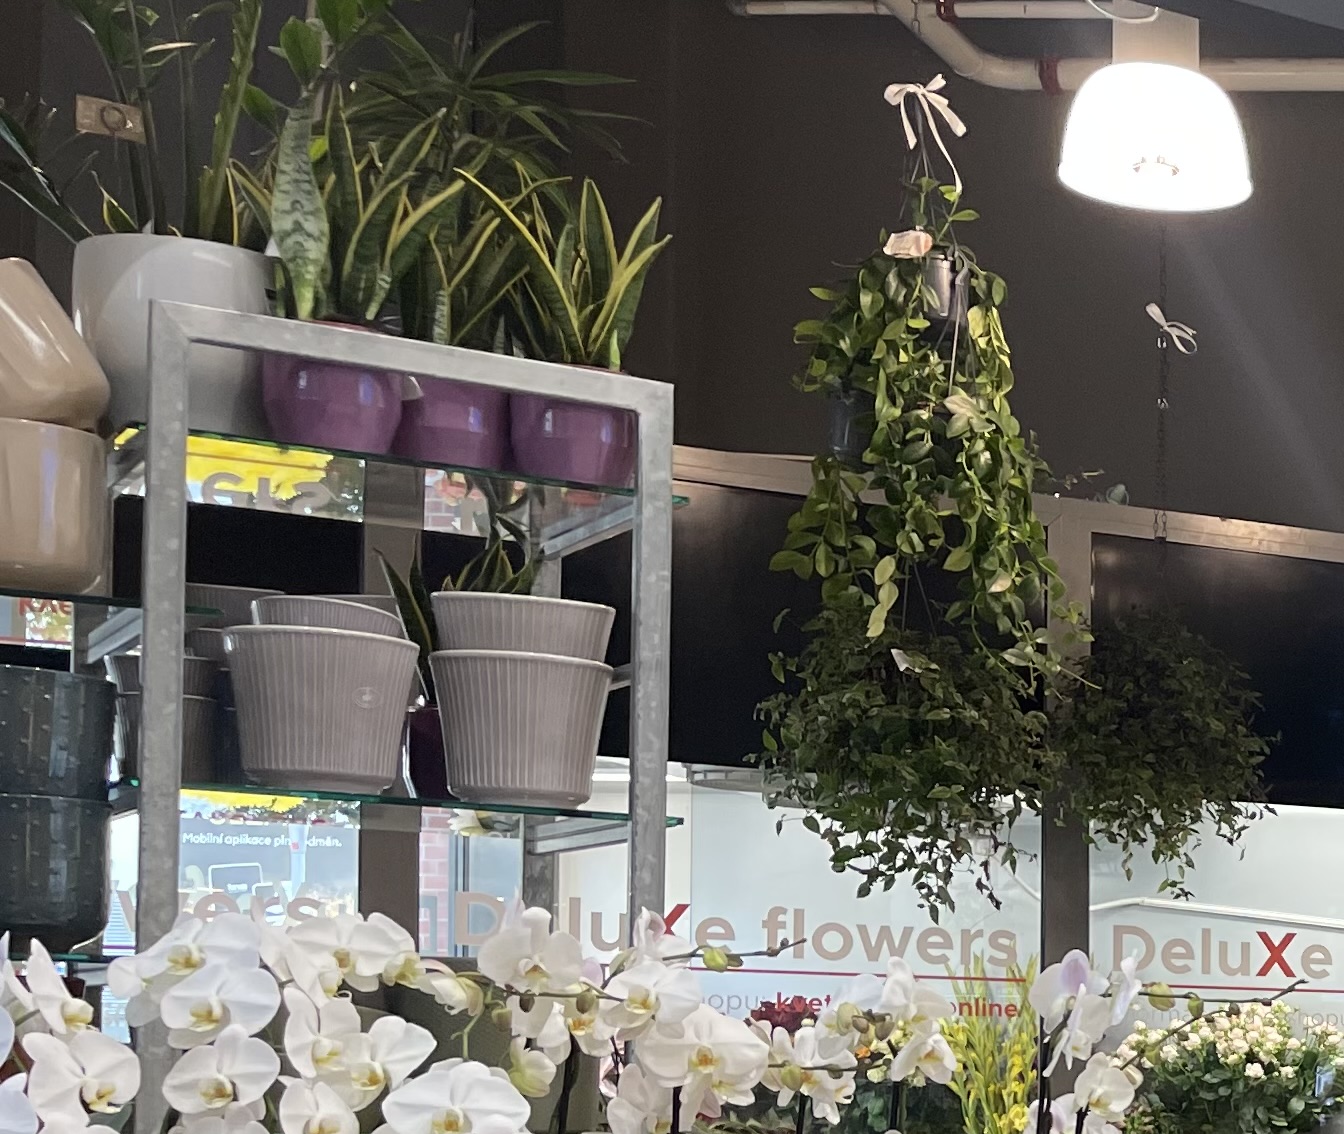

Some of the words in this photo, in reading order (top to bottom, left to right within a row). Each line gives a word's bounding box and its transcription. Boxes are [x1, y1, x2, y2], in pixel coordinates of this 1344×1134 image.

[182, 832, 223, 845] Mobilní
[224, 833, 271, 847] aplikace
[761, 906, 1018, 967] flowers
[1113, 924, 1333, 980] DeluXe
